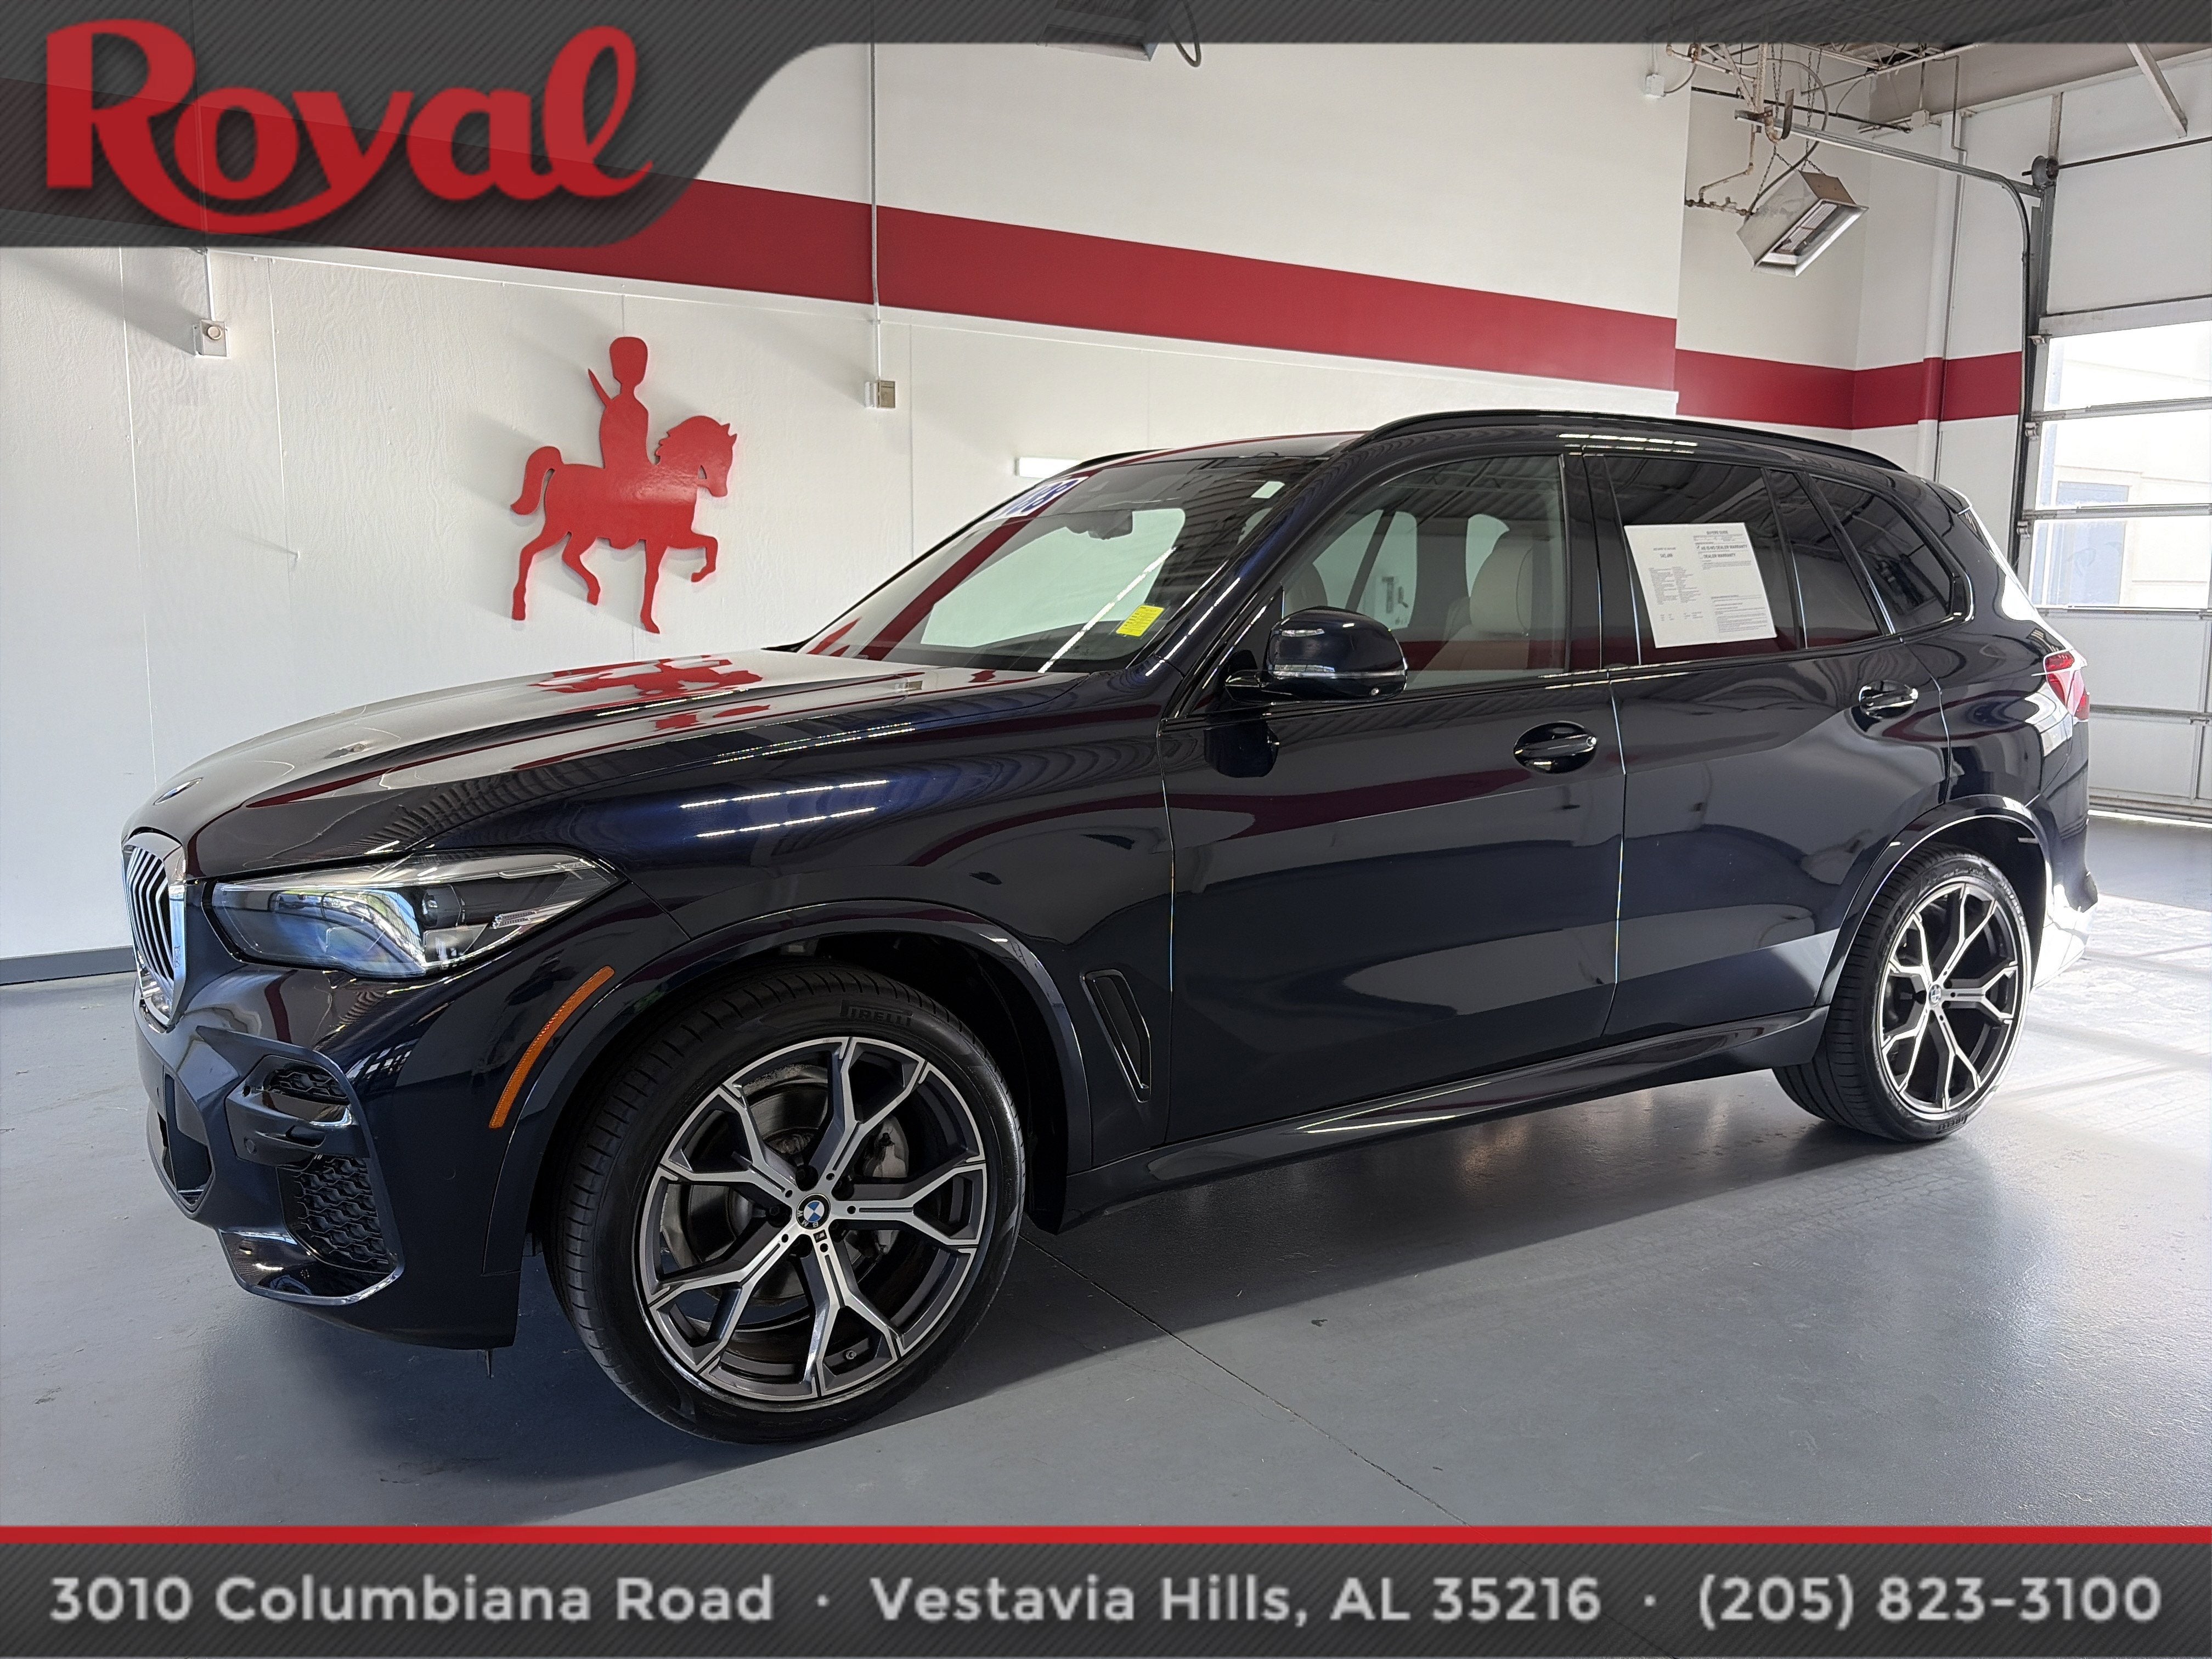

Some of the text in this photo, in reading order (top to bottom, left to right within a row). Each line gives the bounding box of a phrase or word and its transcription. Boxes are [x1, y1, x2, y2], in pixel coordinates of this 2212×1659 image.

[840, 1000, 913, 1026] PIRELLI
[1936, 1114, 1968, 1135] PIRELLI
[797, 1210, 819, 1228] BMW
